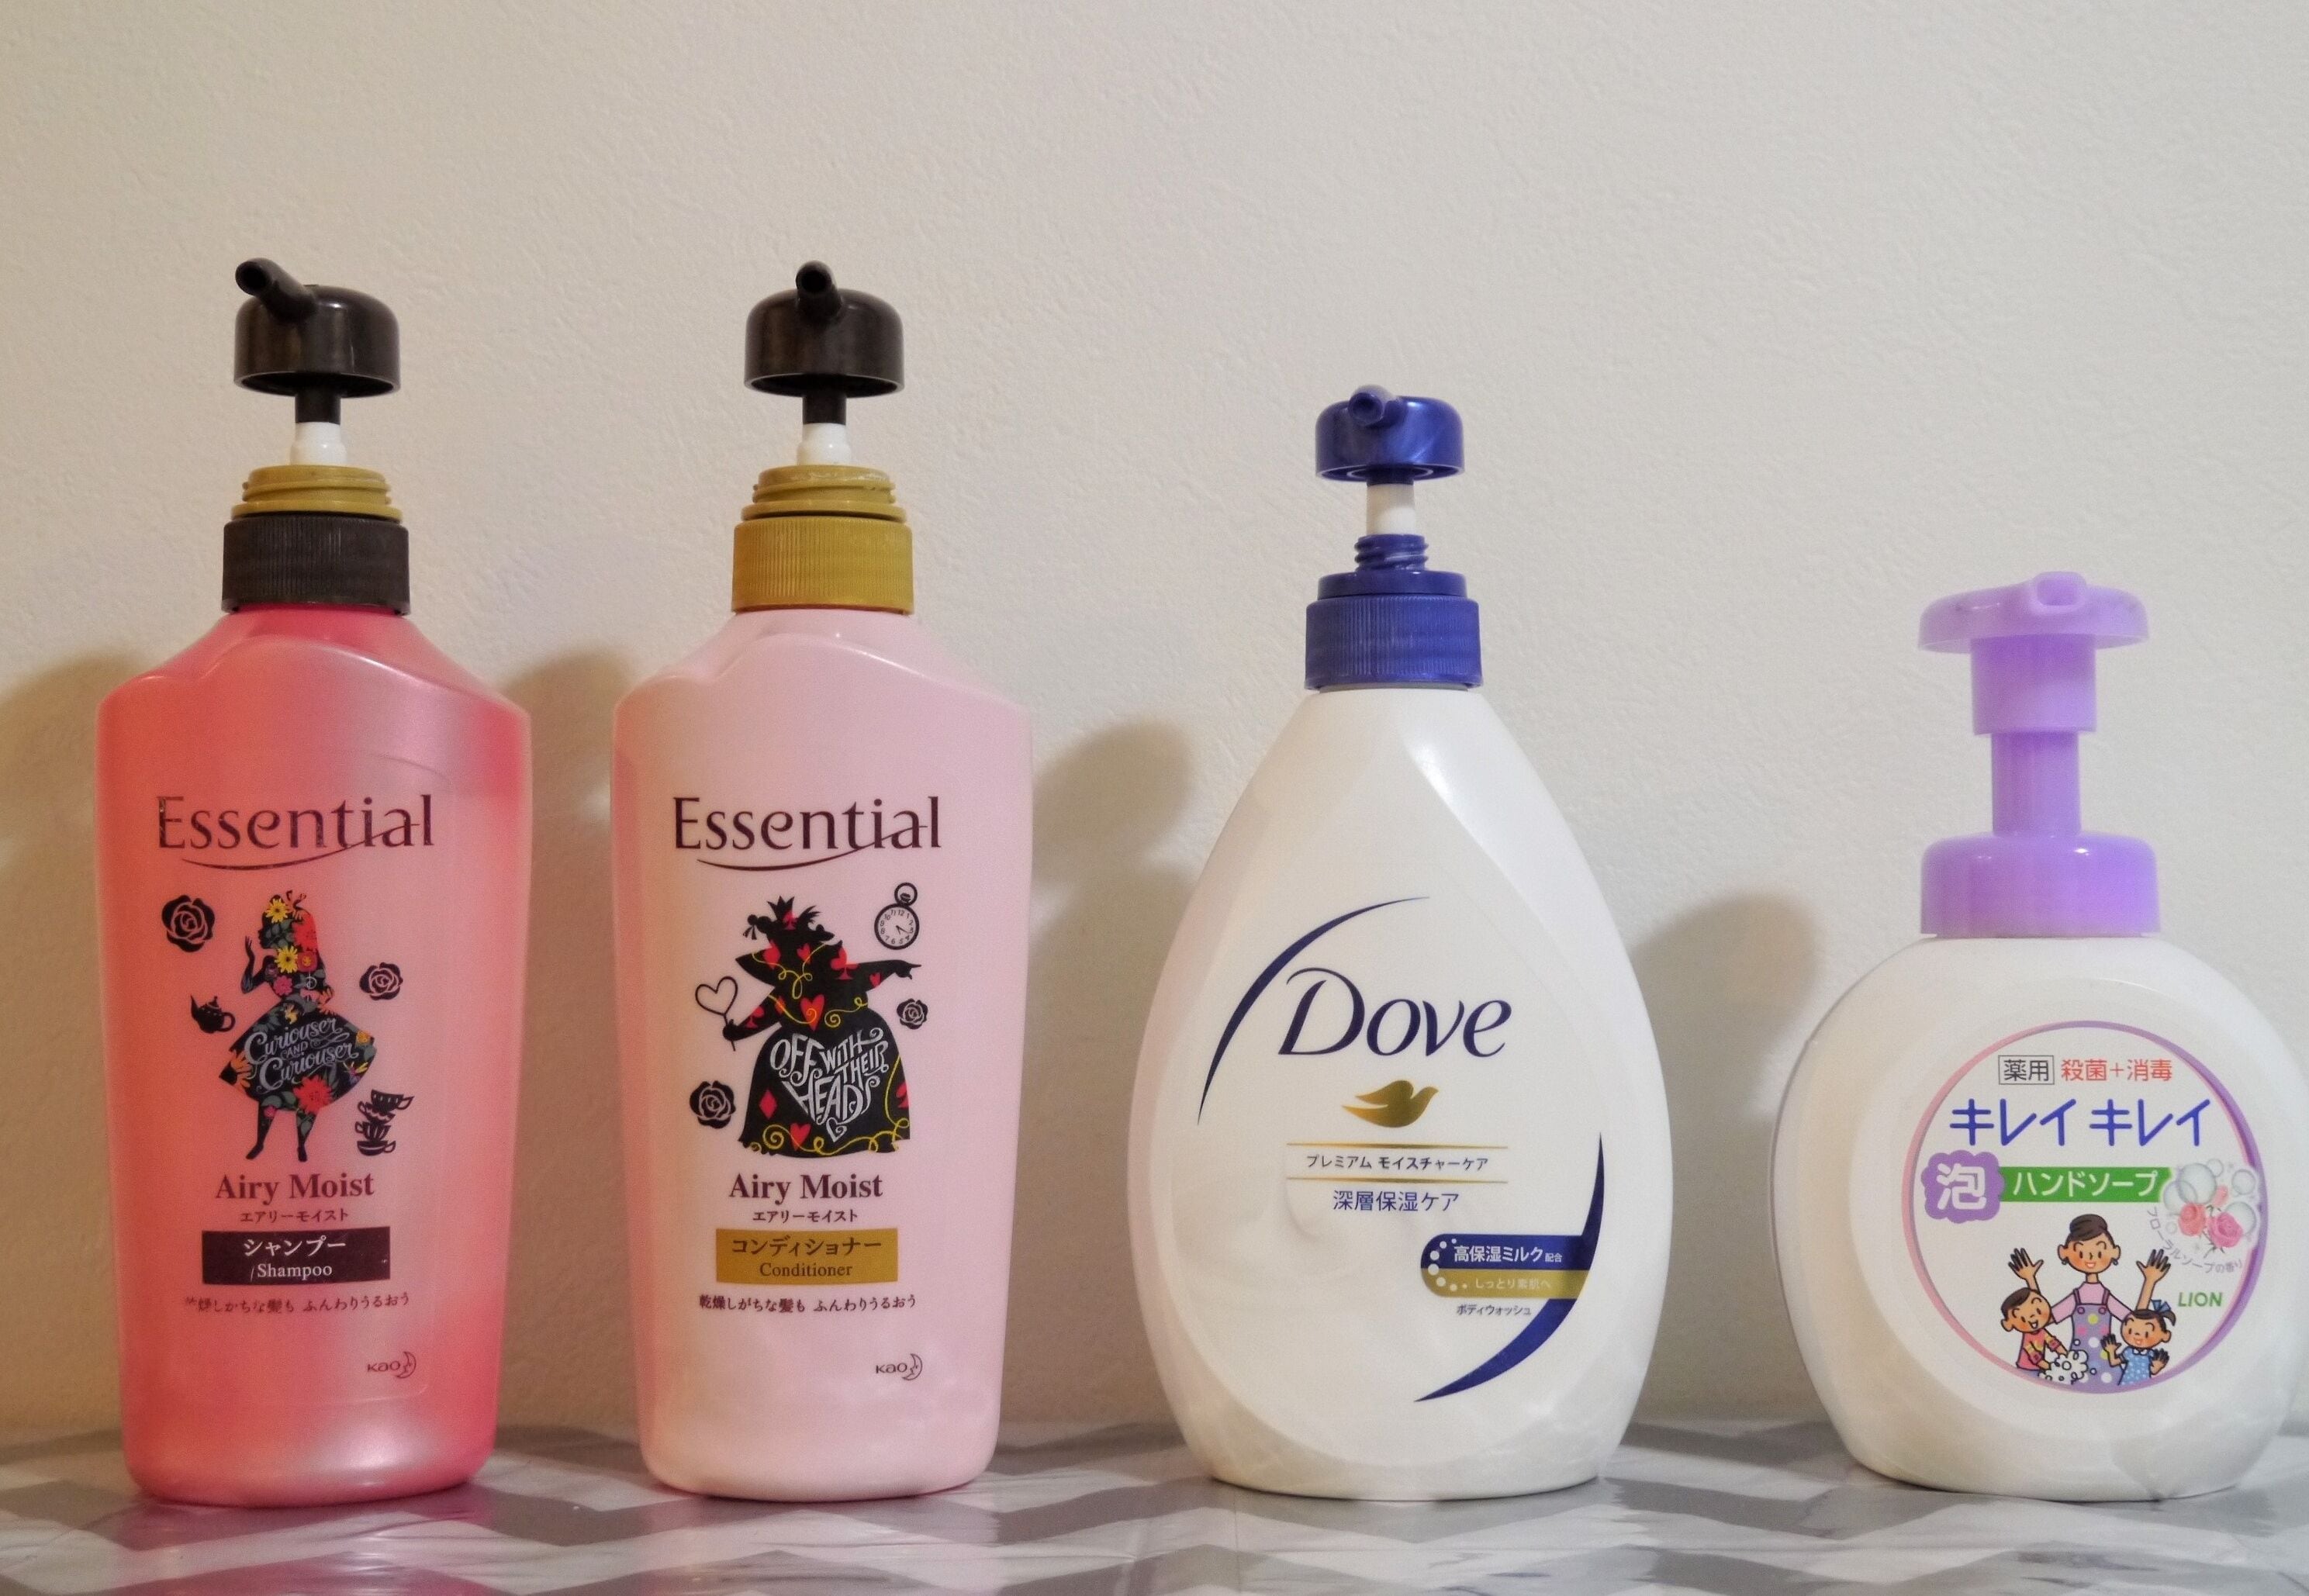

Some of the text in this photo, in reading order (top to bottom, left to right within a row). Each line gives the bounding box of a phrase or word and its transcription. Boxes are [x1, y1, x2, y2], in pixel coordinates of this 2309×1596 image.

[157, 794, 434, 849] Essential
[673, 796, 941, 850] Essential
[1278, 967, 1512, 1058] Dove
[244, 1017, 344, 1066] Curiouser
[259, 1043, 359, 1092] Curiouser
[769, 1028, 883, 1086] OFF WITH
[834, 1040, 890, 1091] THEIR
[2003, 1058, 2173, 1082] 薬用 殺菌+消毒
[782, 1068, 881, 1126] HEADS
[1949, 1098, 2210, 1147] キレイ キレイ
[1306, 1154, 1488, 1170] プレミアム モイスチャーケア
[216, 1173, 375, 1206] Airy Moist
[728, 1173, 883, 1206] Airy Moist
[1936, 1162, 2159, 1211] 泡 ハンドソープ
[1333, 1189, 1460, 1211] 深層保湿ケア
[240, 1208, 349, 1223] エアリーモイスト
[752, 1209, 859, 1224] エアリーモイスト
[244, 1235, 347, 1257] シャンプー
[731, 1235, 882, 1257] コンディショナー
[257, 1263, 333, 1280] Shampoo
[759, 1262, 853, 1278] Conditioner
[302, 1292, 410, 1312] ふんわりうるおう
[700, 1294, 916, 1314] 乾燥しがちな髪も ふんわりうるおう
[1457, 1304, 1532, 1316] ボディウォッシュ
[2177, 1291, 2223, 1308] LION
